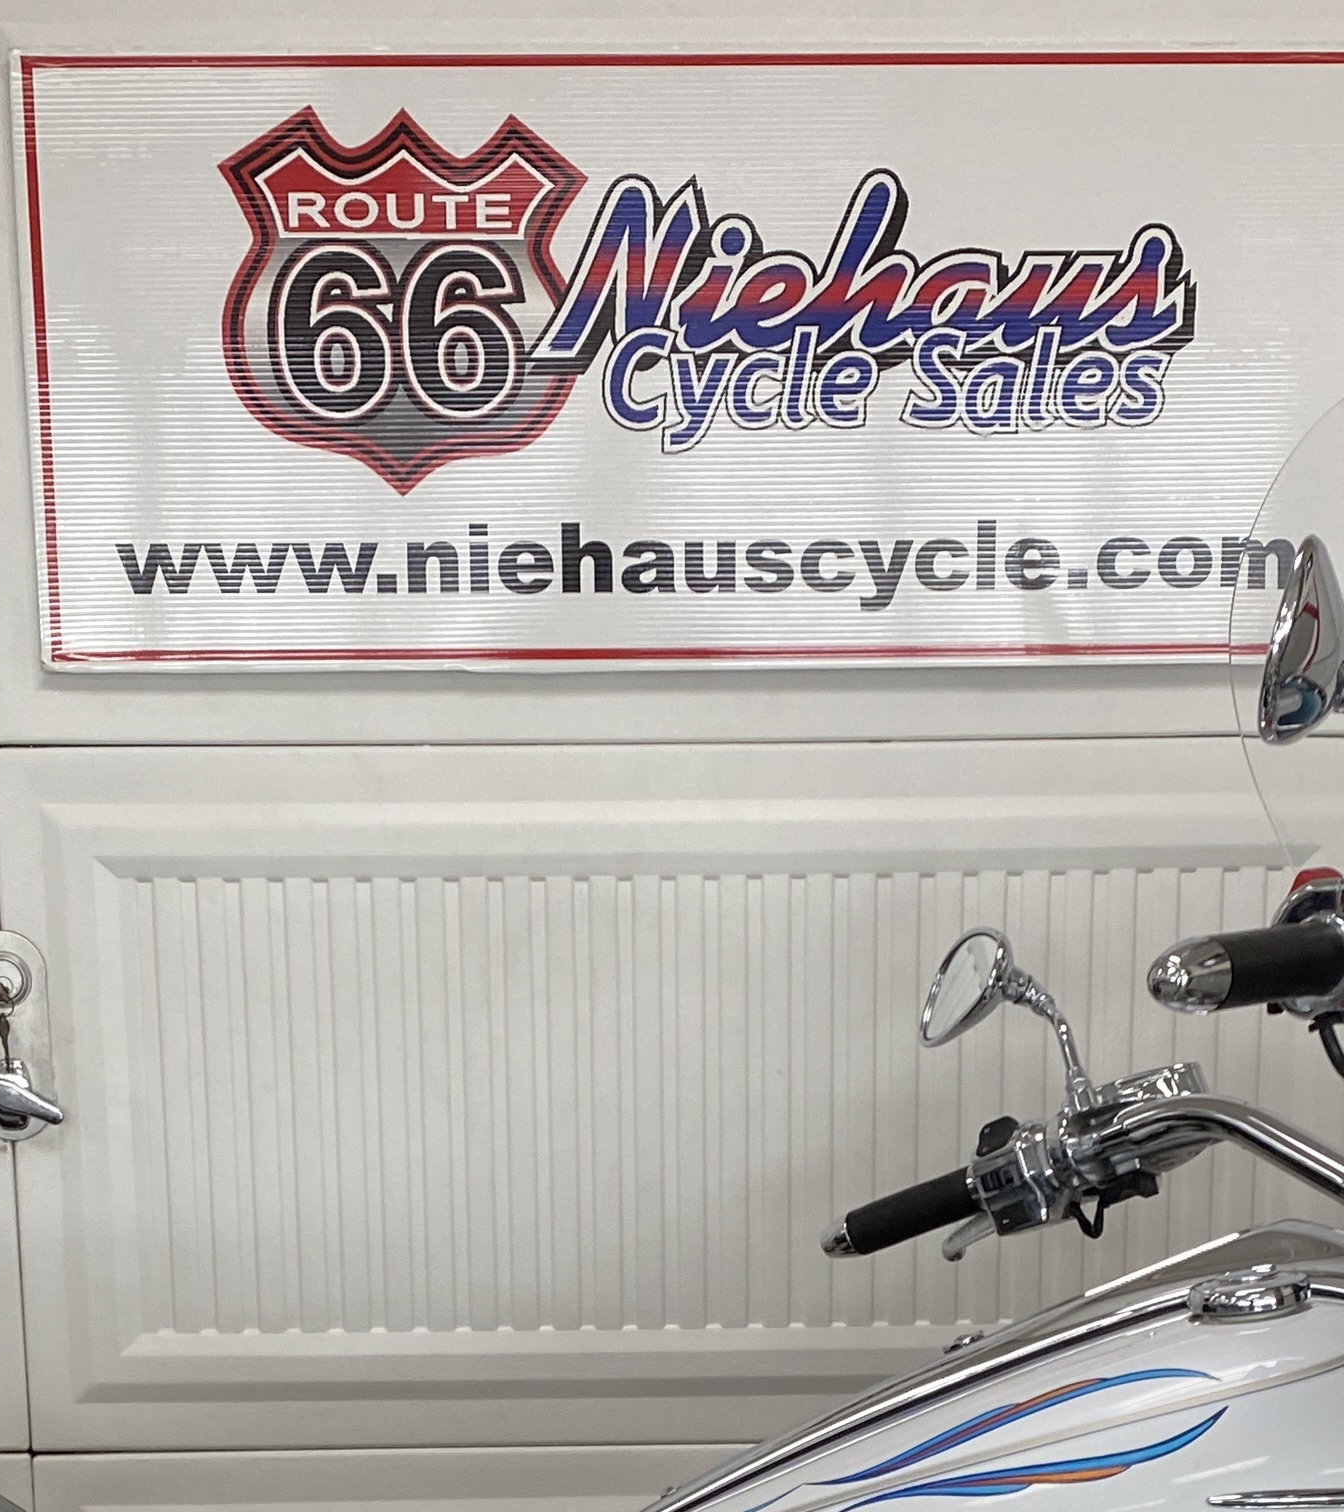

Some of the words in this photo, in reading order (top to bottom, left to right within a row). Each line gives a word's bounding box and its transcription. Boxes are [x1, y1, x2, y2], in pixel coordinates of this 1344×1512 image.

[287, 191, 512, 230] ROUTE
[535, 168, 1197, 364] Niehaus
[268, 240, 525, 426] 66
[602, 325, 880, 453] Cycle
[899, 325, 1176, 434] Sales
[115, 519, 1296, 612] www.niehauscycle.com
